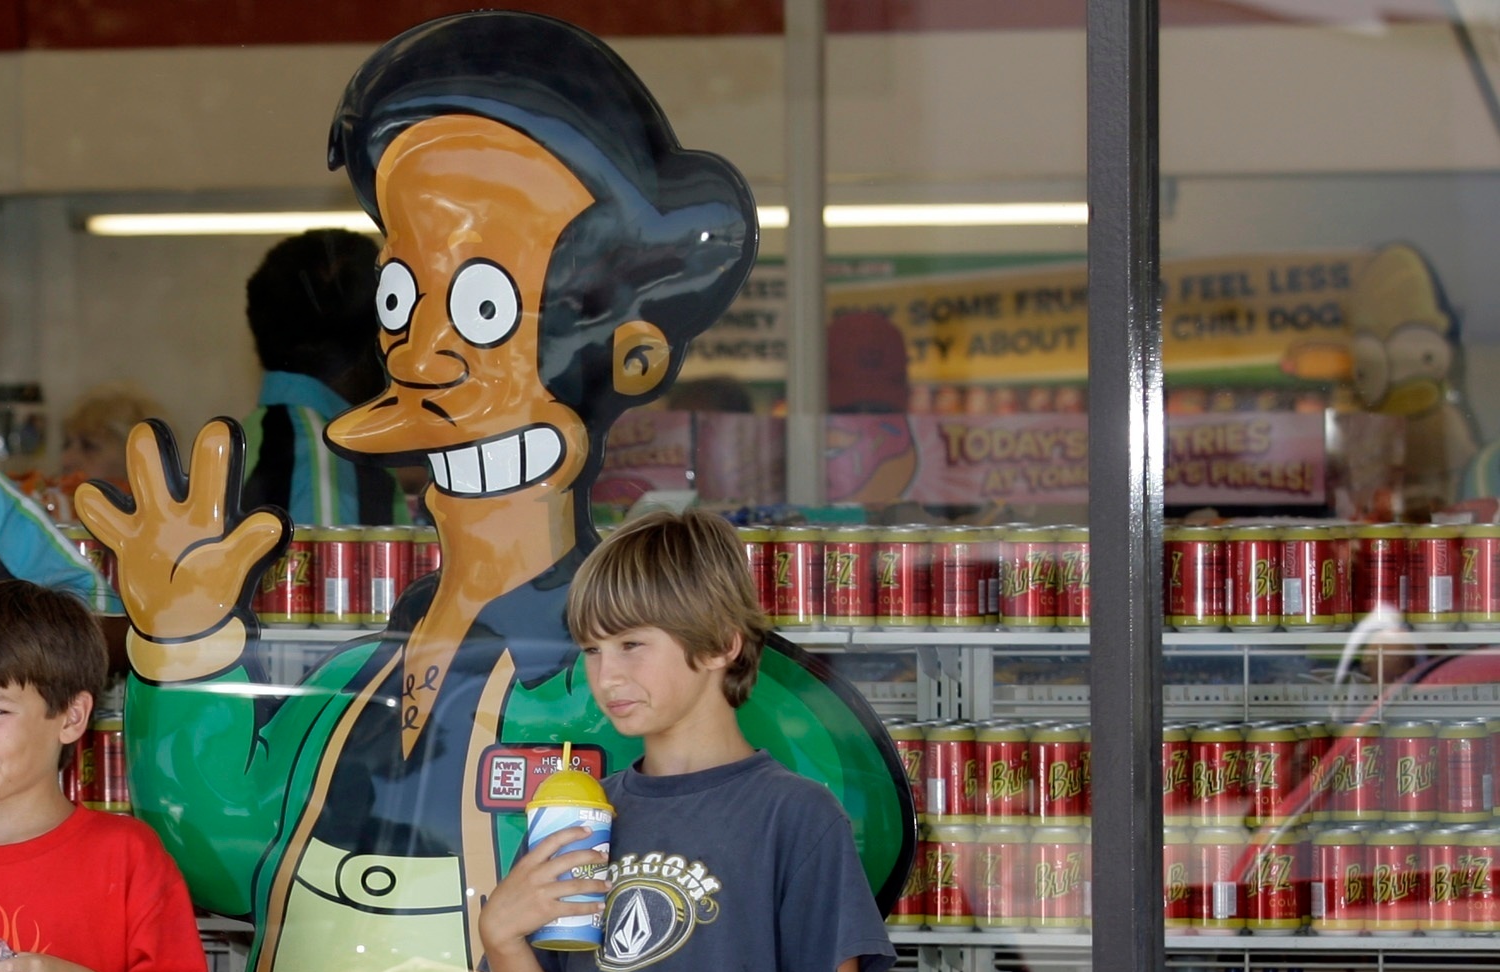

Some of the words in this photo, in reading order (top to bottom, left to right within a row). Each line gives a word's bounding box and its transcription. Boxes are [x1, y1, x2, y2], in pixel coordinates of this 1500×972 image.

[908, 293, 1003, 326] SOME
[1181, 272, 1255, 302] FEEL
[1268, 263, 1349, 294] LESS
[967, 325, 1080, 359] ABOUT
[937, 423, 1088, 468] TODAY'S
[1170, 420, 1271, 460] TRIES
[495, 761, 523, 771] KWIK
[492, 787, 522, 797] MART
